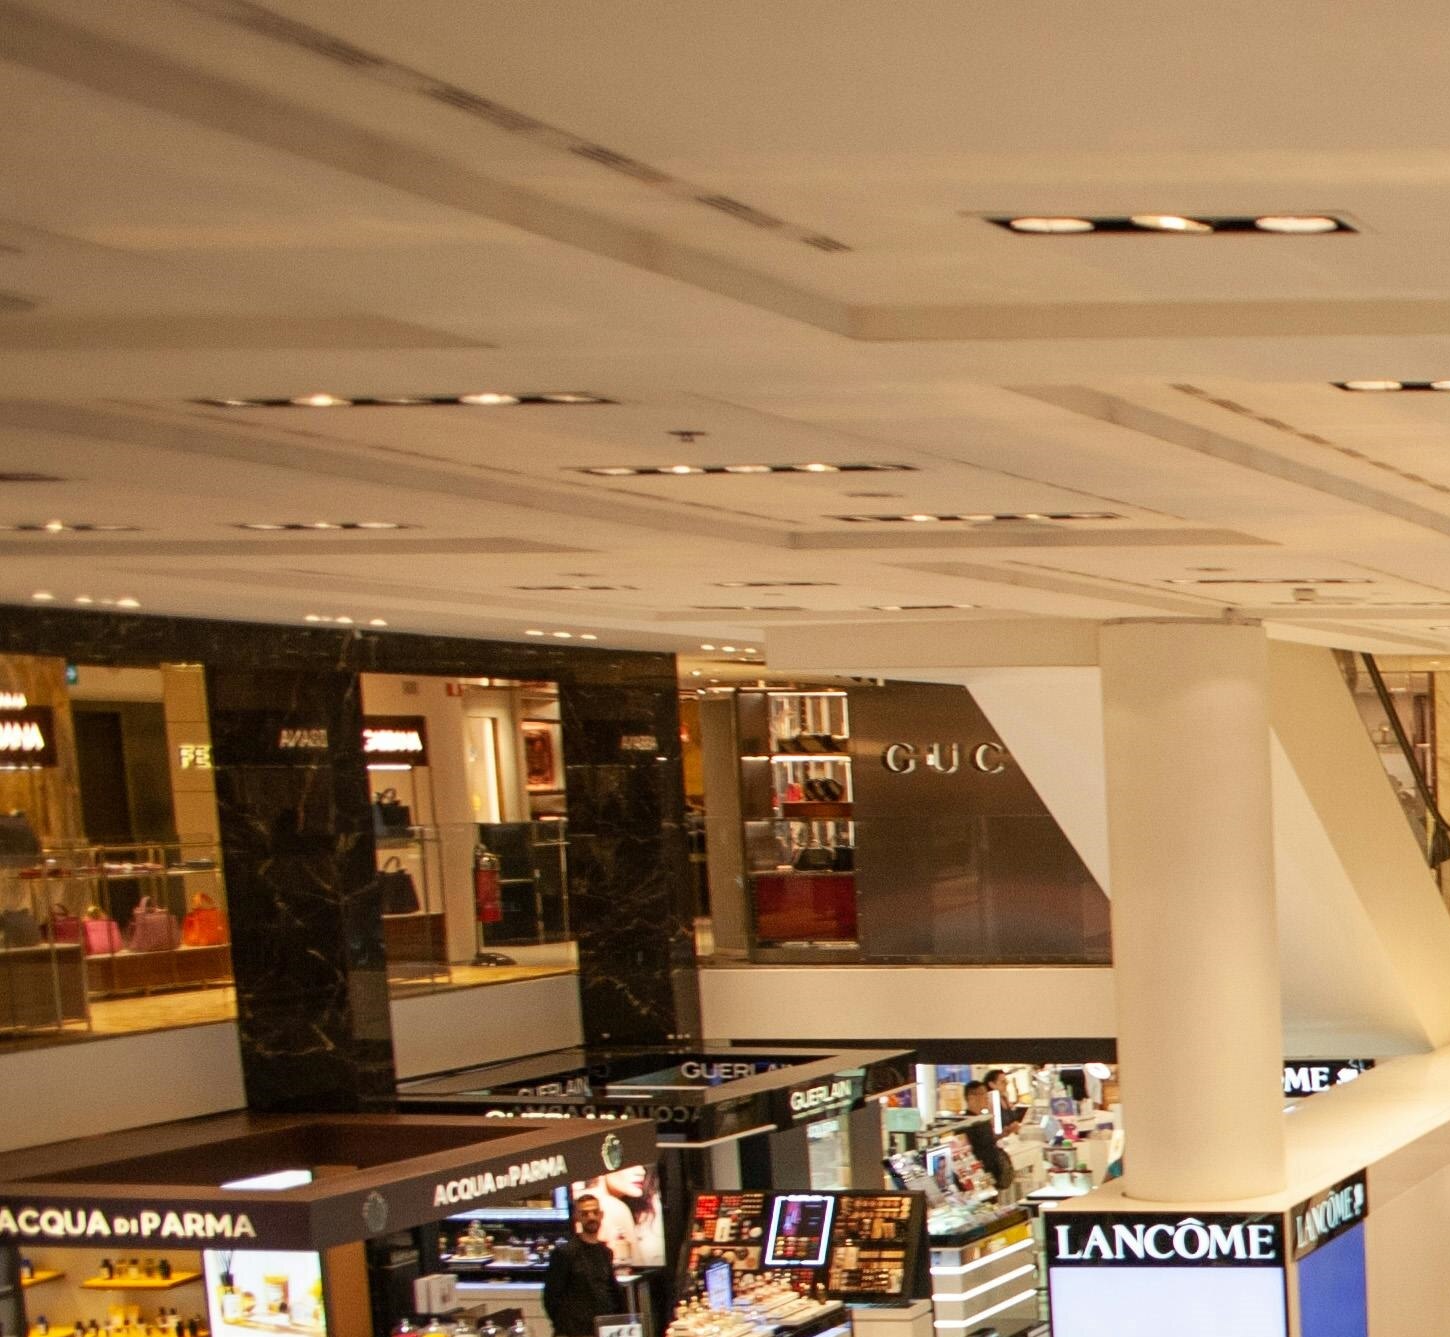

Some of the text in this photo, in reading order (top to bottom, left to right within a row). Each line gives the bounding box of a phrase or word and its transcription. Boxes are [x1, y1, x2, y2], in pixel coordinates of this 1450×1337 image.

[791, 1079, 852, 1111] GUERLAIN
[1283, 1066, 1330, 1092] ME
[434, 1170, 494, 1207] ACQUA
[508, 1155, 567, 1187] PARMA
[0, 1209, 110, 1237] ACQUA
[140, 1211, 256, 1238] PARMA
[1056, 1217, 1276, 1259] LANCÔME
